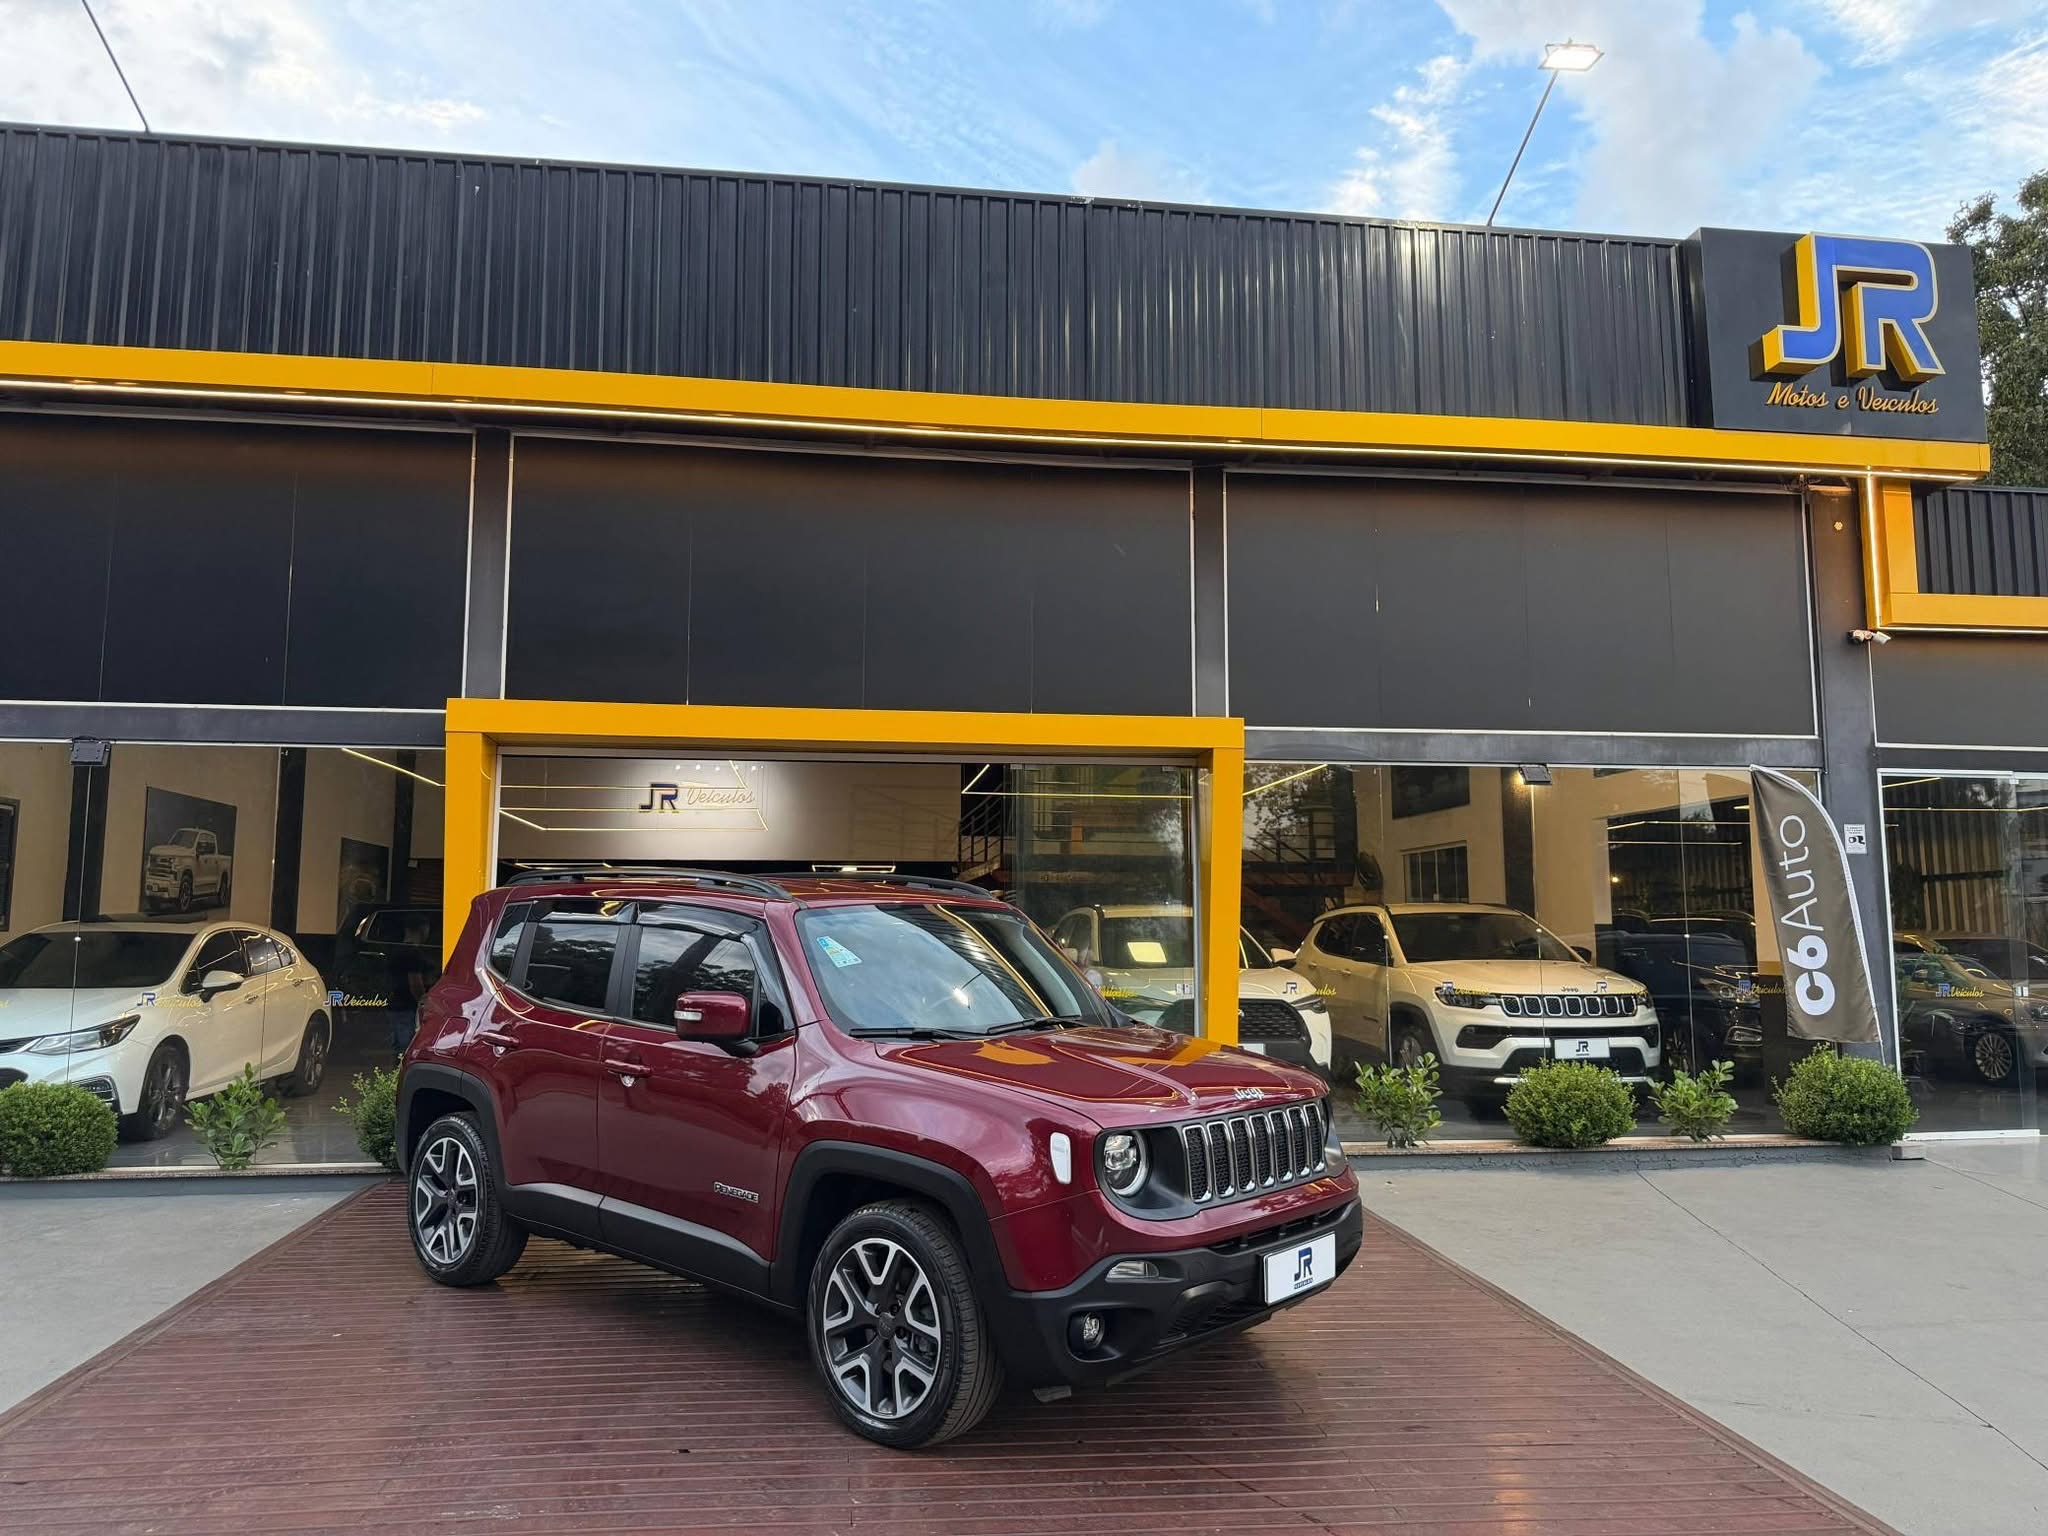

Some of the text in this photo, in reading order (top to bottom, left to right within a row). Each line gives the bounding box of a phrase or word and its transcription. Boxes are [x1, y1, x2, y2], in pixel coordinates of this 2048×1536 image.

[1764, 232, 1946, 382] JR
[1766, 381, 1829, 409] Motos
[1837, 394, 1850, 410] e
[639, 783, 679, 811] JR
[1281, 981, 1298, 995] JR
[1593, 981, 1608, 994] JR
[1936, 983, 1950, 997] JR
[136, 992, 156, 1007] JR
[323, 990, 343, 1006] JR
[1575, 1040, 1590, 1053] JR
[1294, 1246, 1312, 1282] JR
